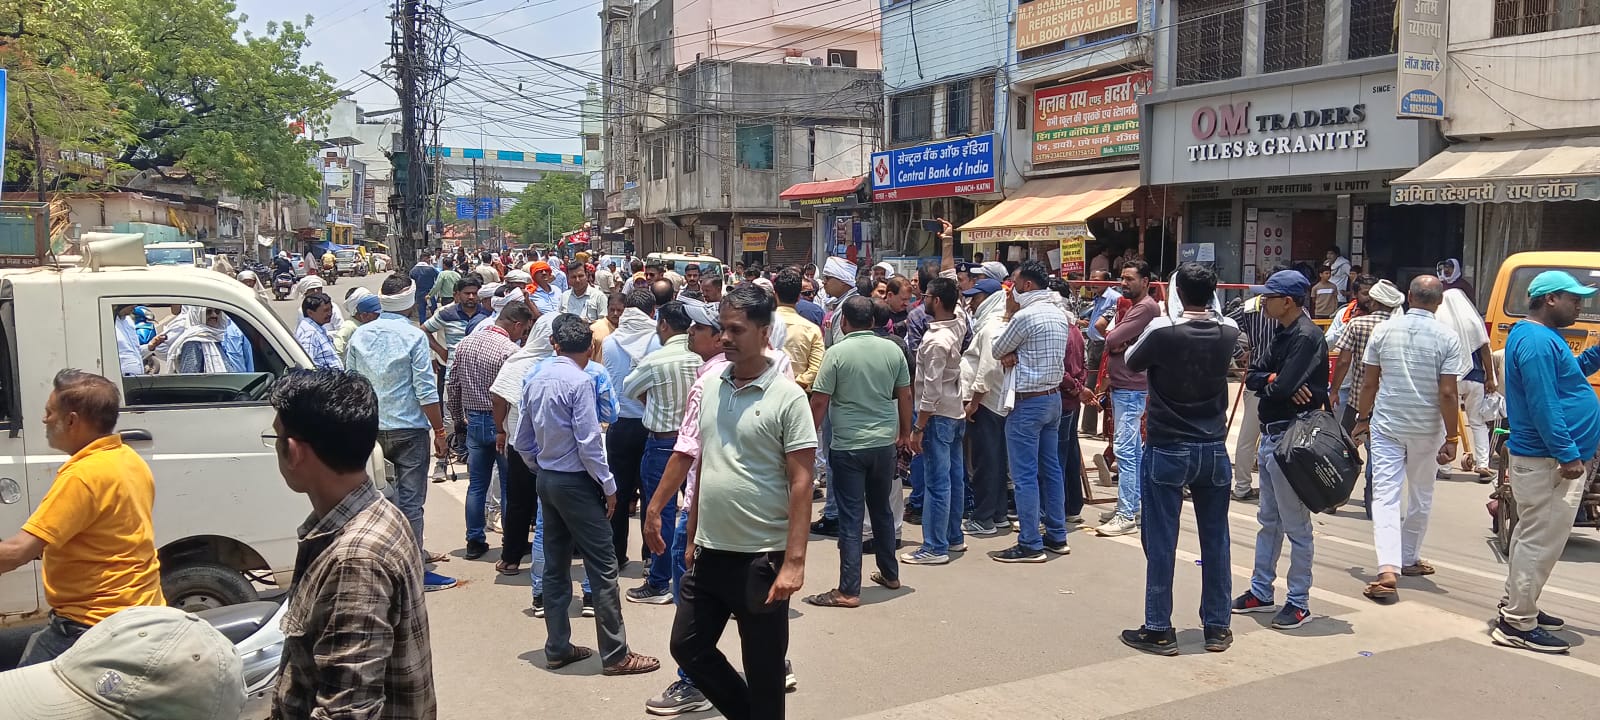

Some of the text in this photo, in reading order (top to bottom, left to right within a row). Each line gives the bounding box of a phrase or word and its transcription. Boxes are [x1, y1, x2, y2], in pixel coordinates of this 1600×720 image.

[1019, 32, 1037, 47] ALL
[1040, 24, 1068, 40] BOOK
[1070, 7, 1133, 34] AVAILABLE
[1029, 7, 1084, 31] REFRESHER
[1087, 0, 1121, 15] GUIDE
[1038, 93, 1068, 120] गुलाब
[1069, 90, 1088, 109] राय
[1104, 77, 1132, 105] ब्रदर्स
[1372, 85, 1391, 94] SINCE
[1191, 101, 1367, 141] OM TRADERS
[897, 151, 921, 167] सेन्ट्रल
[923, 148, 938, 161] बैंक
[962, 140, 990, 157] इंडिया
[898, 159, 989, 183] Central Bank of India
[1231, 186, 1258, 196] CEMENT
[1267, 184, 1284, 194] PIPE
[1284, 183, 1312, 193] FITTING
[1344, 180, 1370, 190] PUTTY
[1394, 179, 1578, 202] अमित स्टेशनरी राय लॉज
